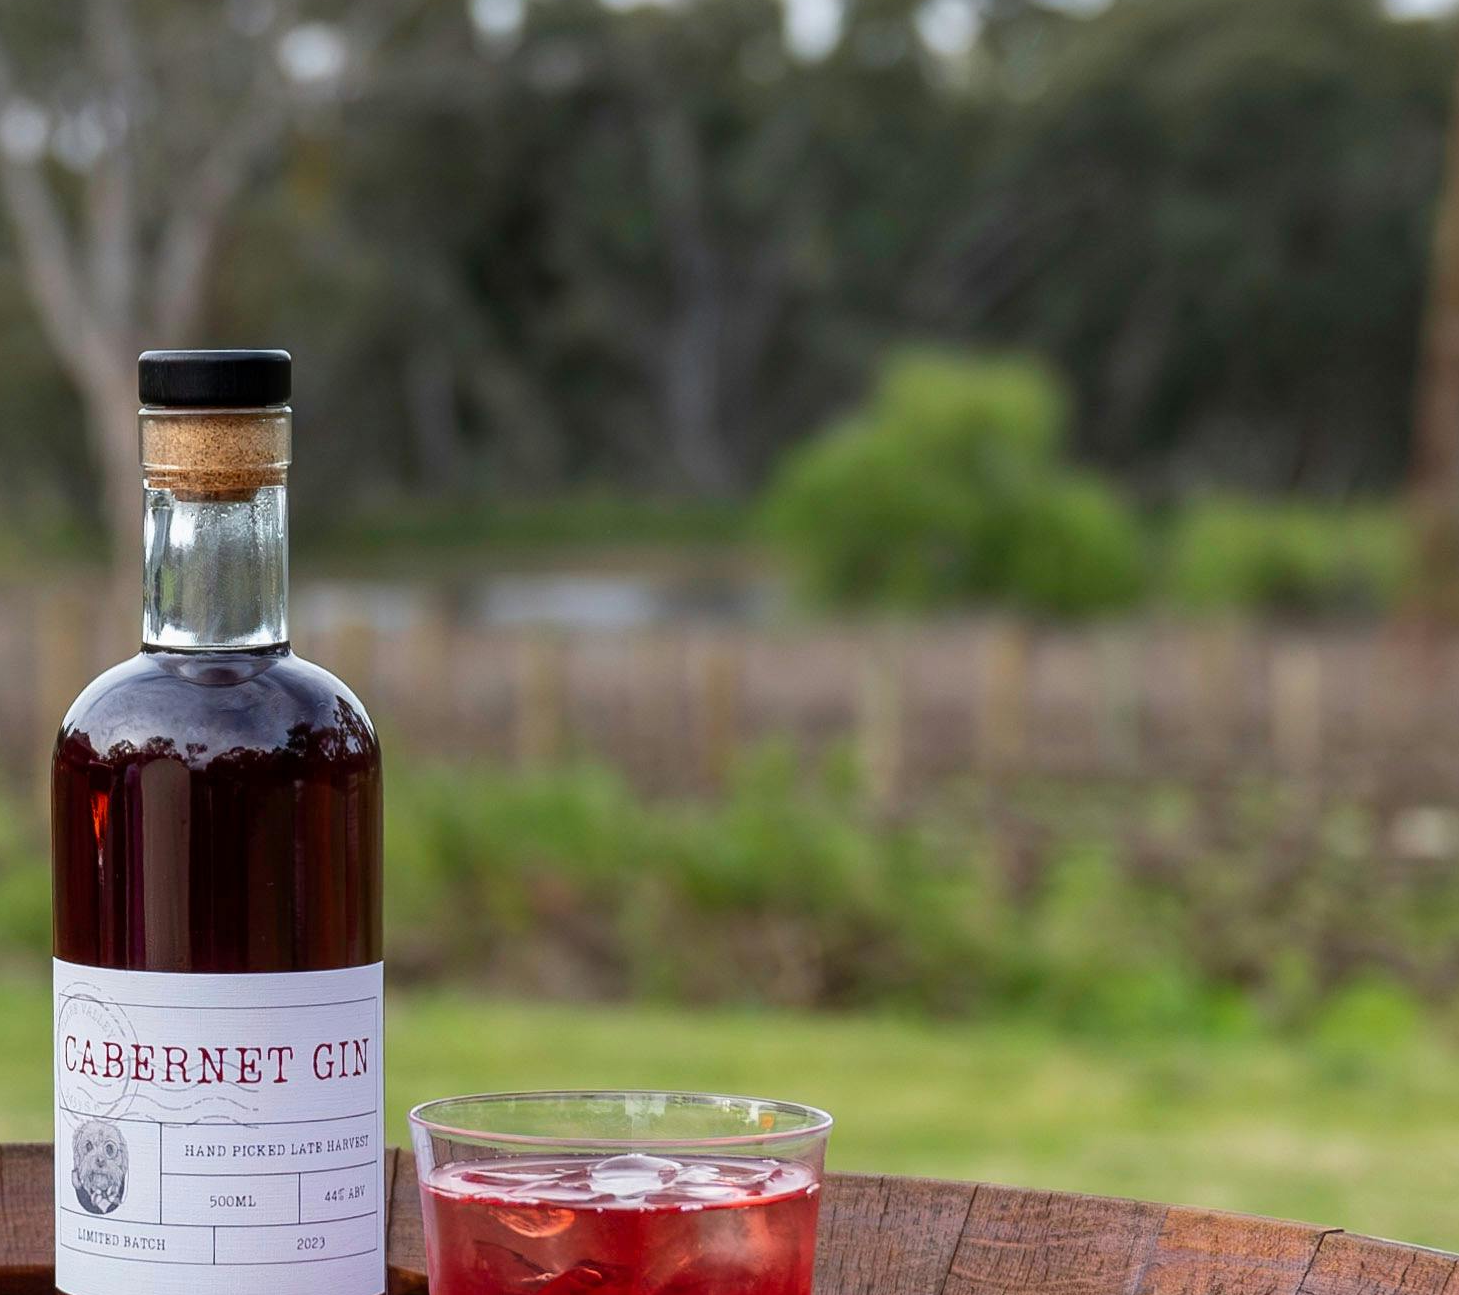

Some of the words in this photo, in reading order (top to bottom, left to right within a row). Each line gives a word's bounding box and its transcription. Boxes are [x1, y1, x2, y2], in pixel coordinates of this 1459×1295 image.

[65, 1035, 293, 1084] CABERNET
[313, 1037, 369, 1080] GIN
[185, 1145, 226, 1157] HAND
[233, 1144, 286, 1157] PICKED
[291, 1141, 323, 1155] LATE
[327, 1134, 369, 1153] HARVEST
[210, 1195, 257, 1208] 500ML
[325, 1187, 345, 1202] 44%
[348, 1185, 366, 1199] ABV
[78, 1228, 119, 1246] LIMITED
[124, 1236, 166, 1251] BATCH
[297, 1237, 326, 1250] 2023
